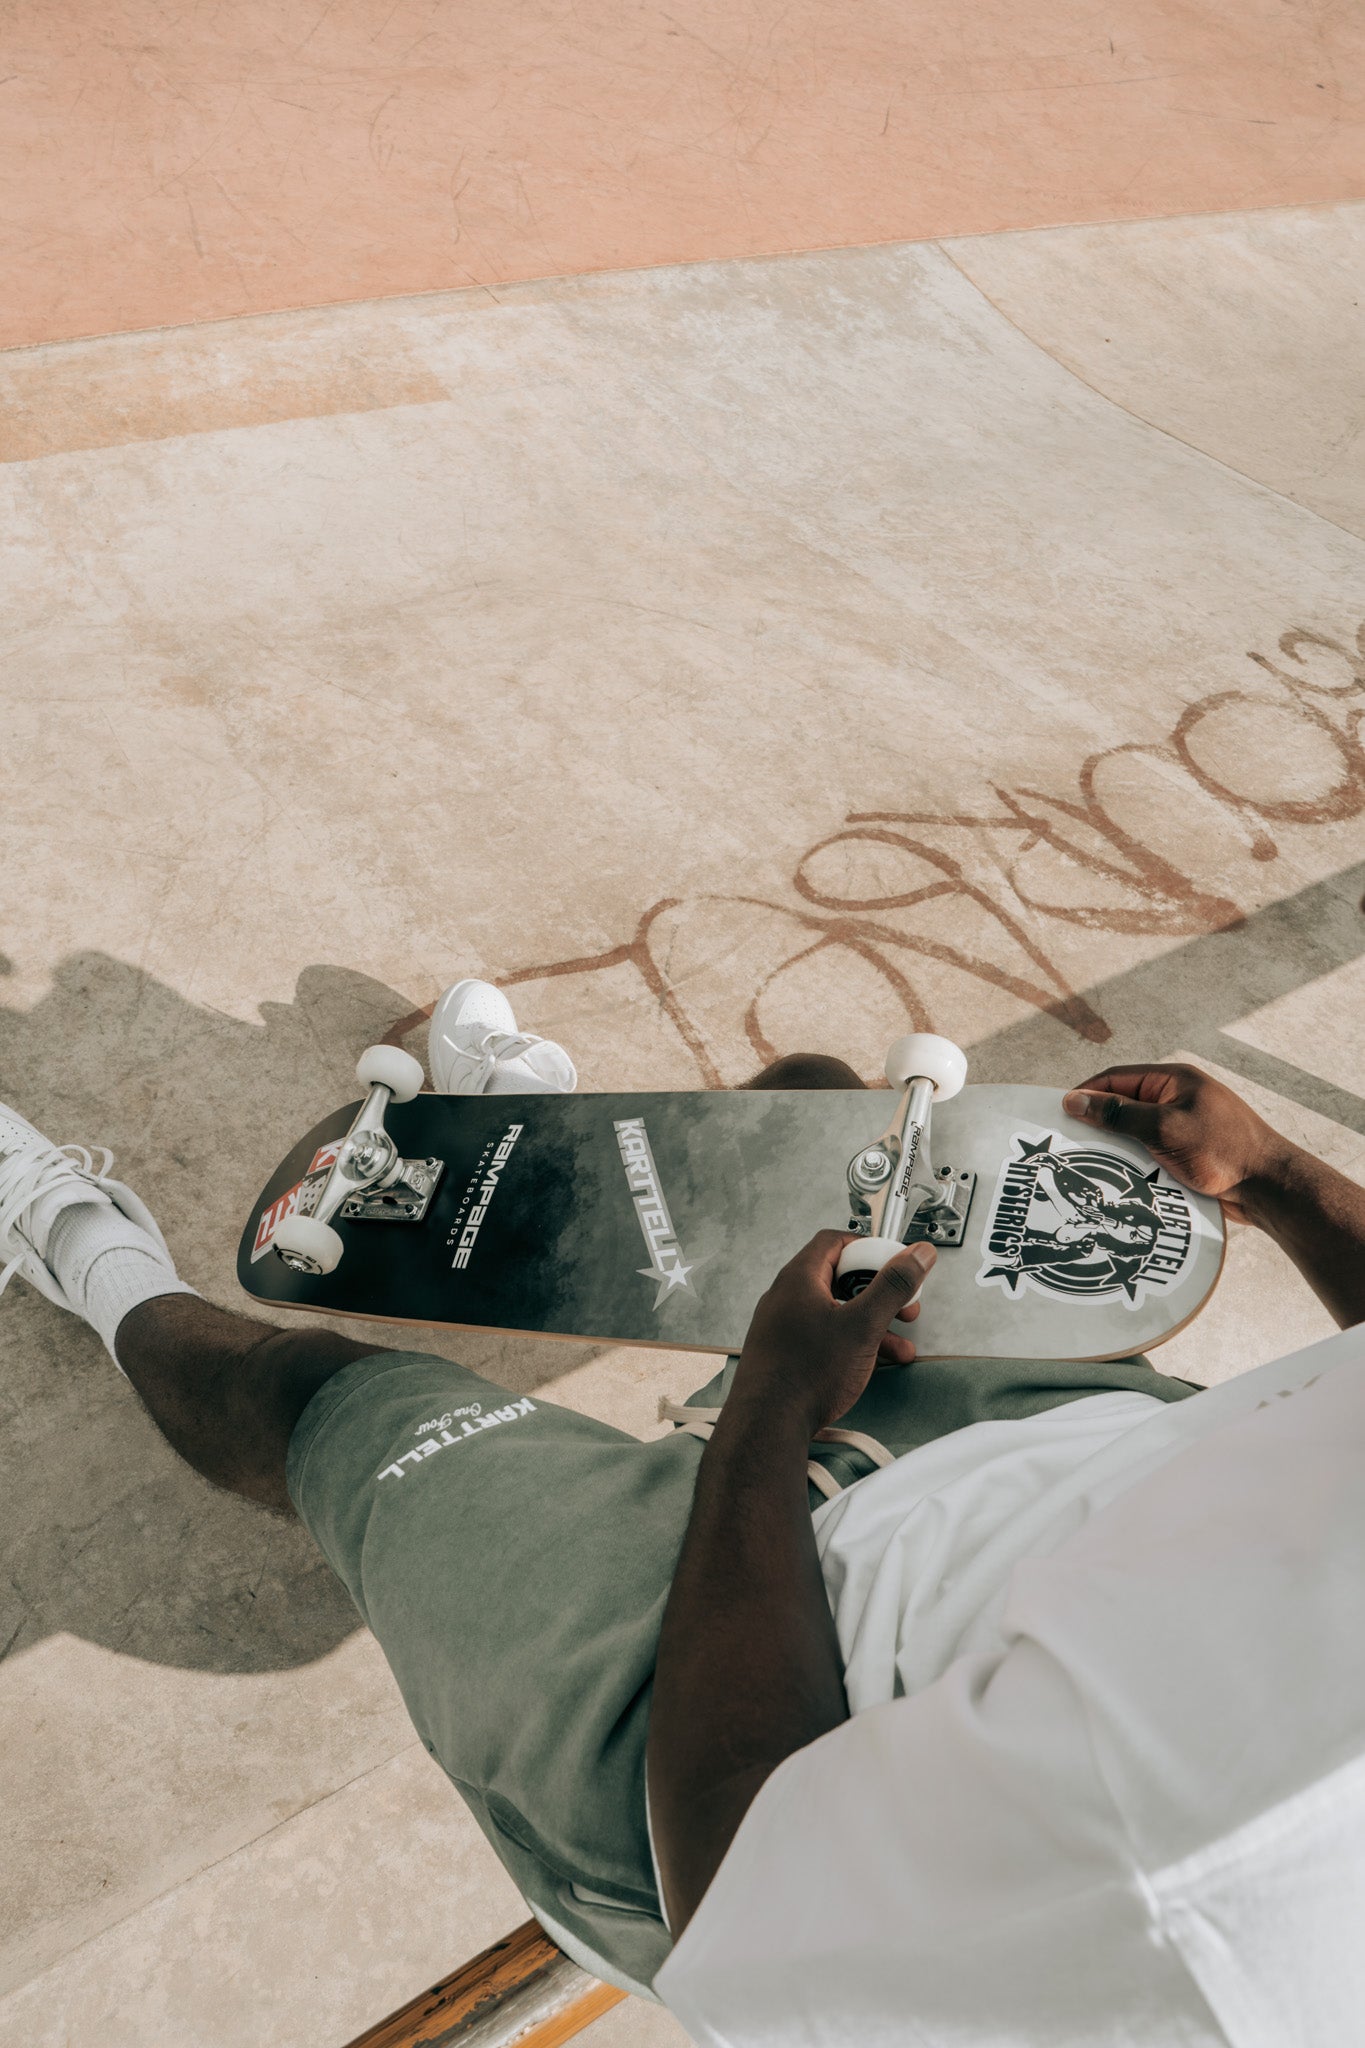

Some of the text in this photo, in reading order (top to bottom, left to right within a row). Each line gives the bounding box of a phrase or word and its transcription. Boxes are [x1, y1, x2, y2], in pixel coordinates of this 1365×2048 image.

[447, 1142, 494, 1246] SKATEBOARDS
[452, 1124, 524, 1269] RAMPAGE
[618, 1120, 677, 1272] KARTTELL
[988, 1162, 1039, 1257] HYSTERICS
[1130, 1183, 1192, 1285] KARTTELL
[377, 1397, 538, 1480] KARTTELL
[414, 1402, 482, 1436] One Four
